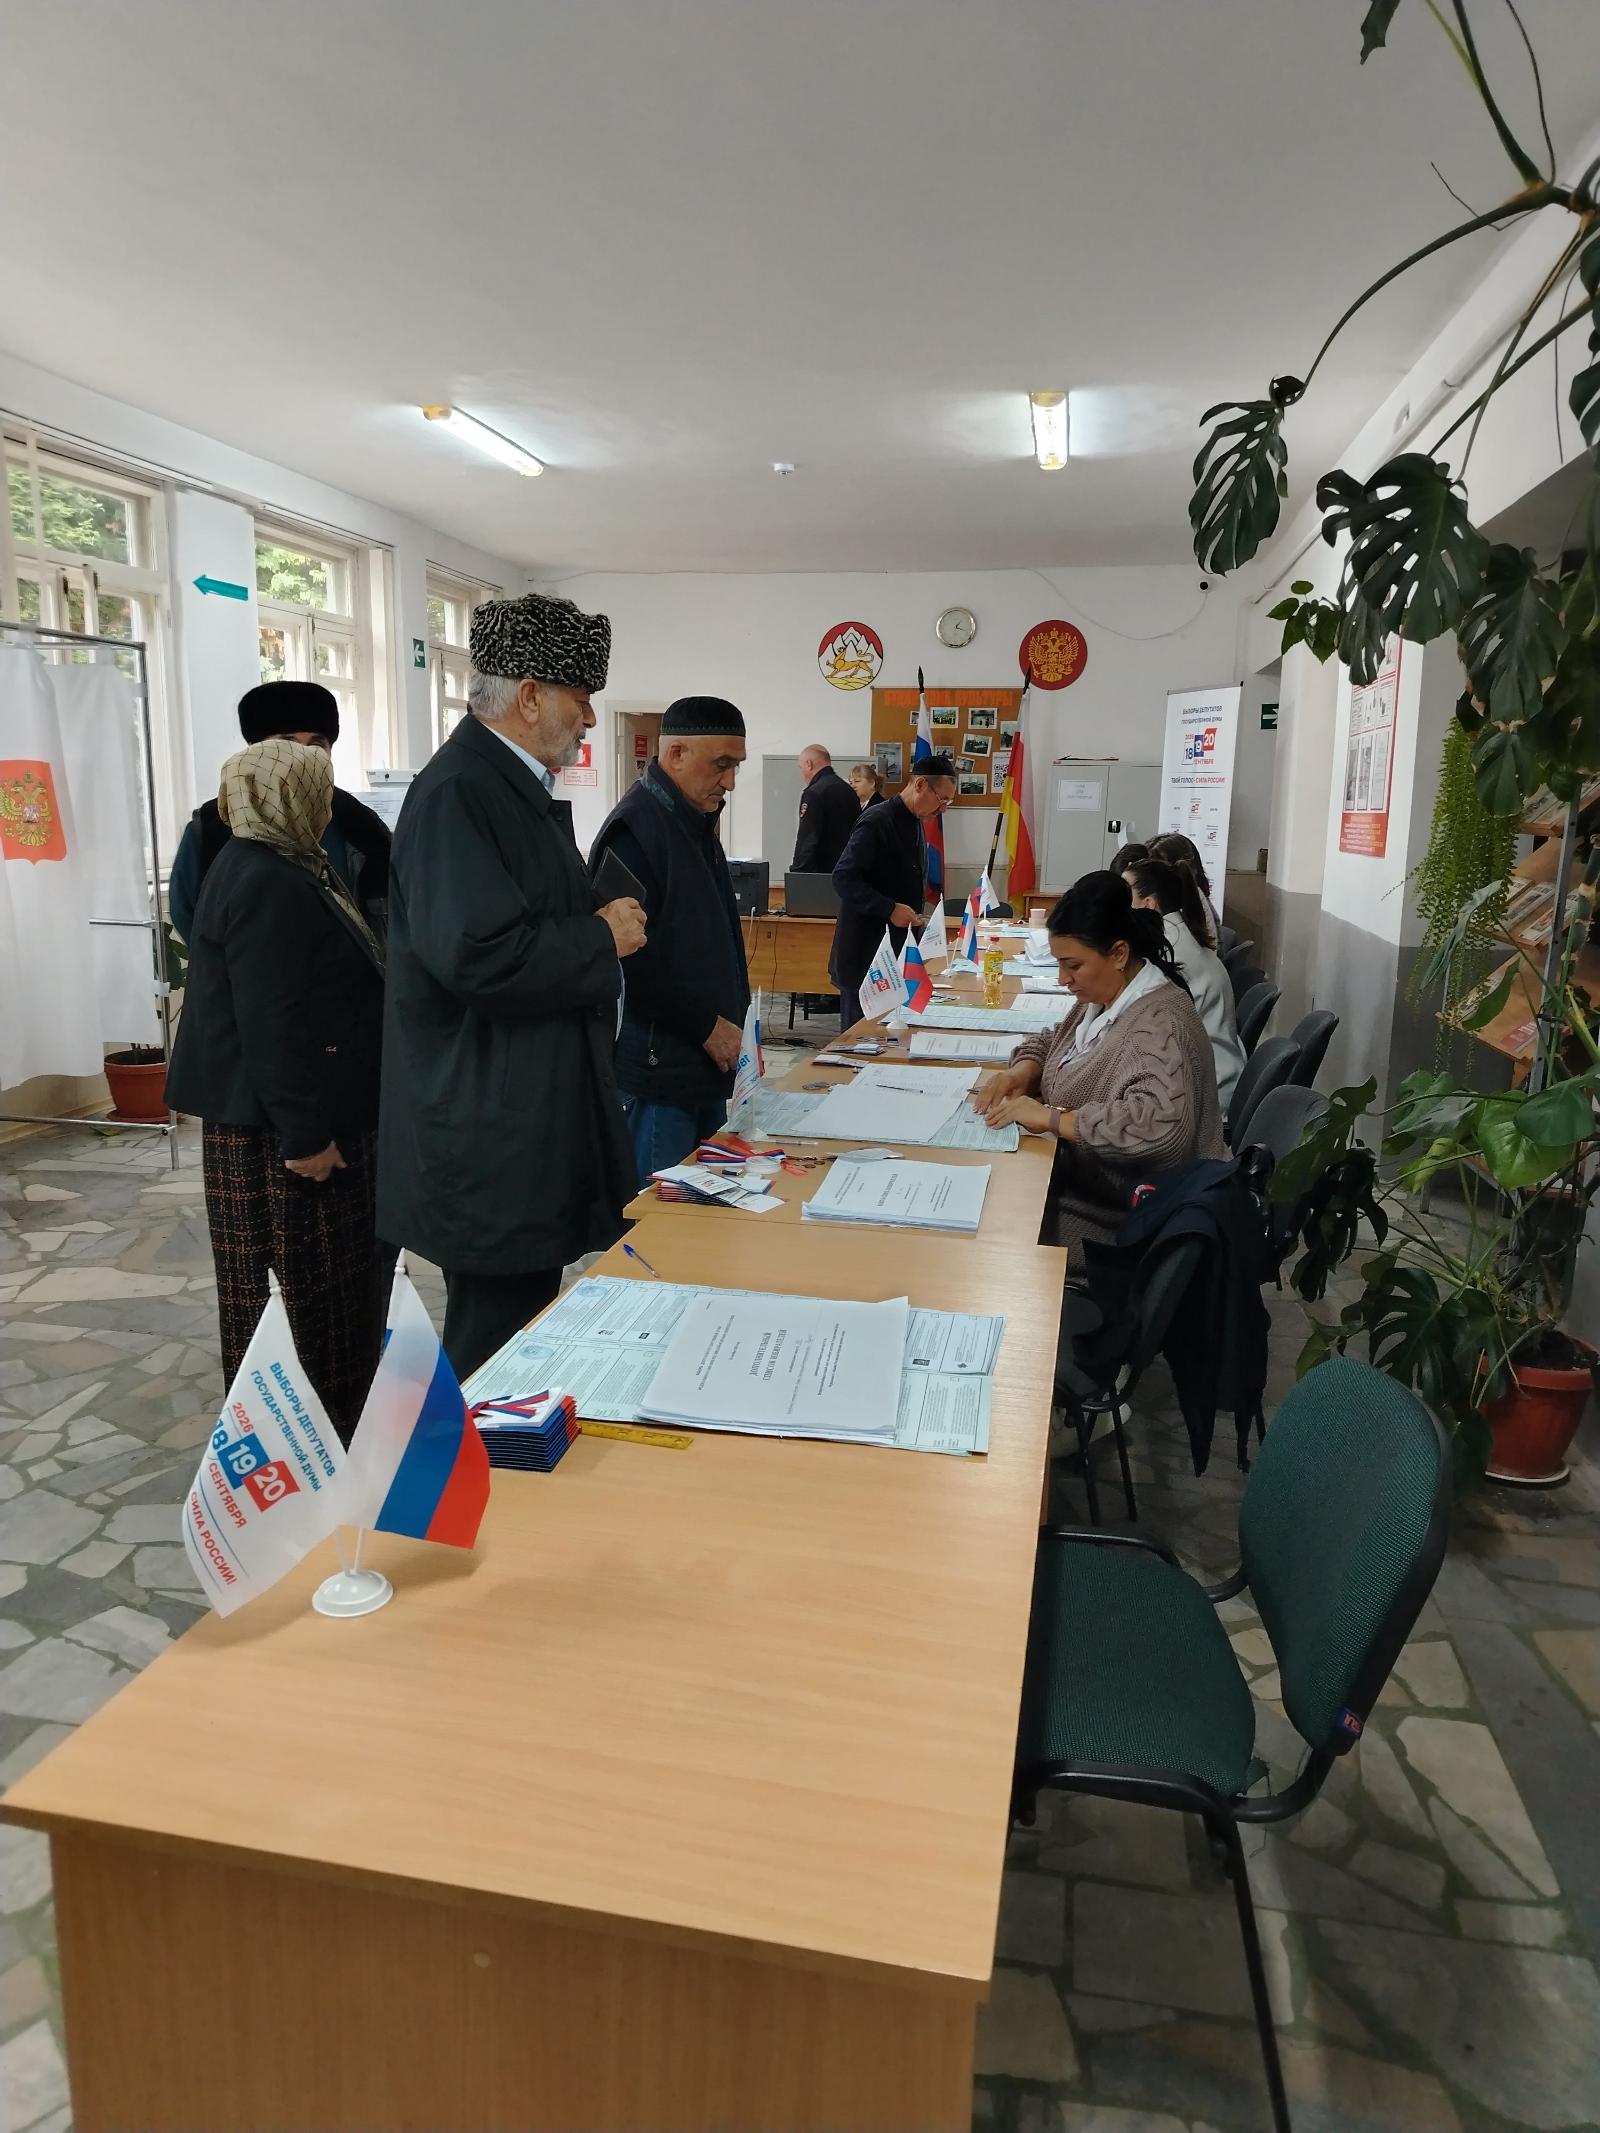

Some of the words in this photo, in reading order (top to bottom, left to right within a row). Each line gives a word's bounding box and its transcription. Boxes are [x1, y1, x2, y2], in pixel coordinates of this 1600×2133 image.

[1185, 747, 1194, 760] 18
[1203, 733, 1215, 747] 20
[232, 1402, 254, 1433] 2026
[251, 1370, 309, 1464] ГОСУДАРСТВЕННОЙ
[301, 1462, 322, 1492] ДУМЫ
[270, 1362, 305, 1415] ВЫБОРЫ
[296, 1414, 336, 1477] ДЕПУТАТОВ
[209, 1462, 247, 1528] СЕНТЯБРЯ
[227, 1443, 257, 1475] 19
[253, 1466, 286, 1502] 20
[191, 1491, 205, 1530] СИЛА
